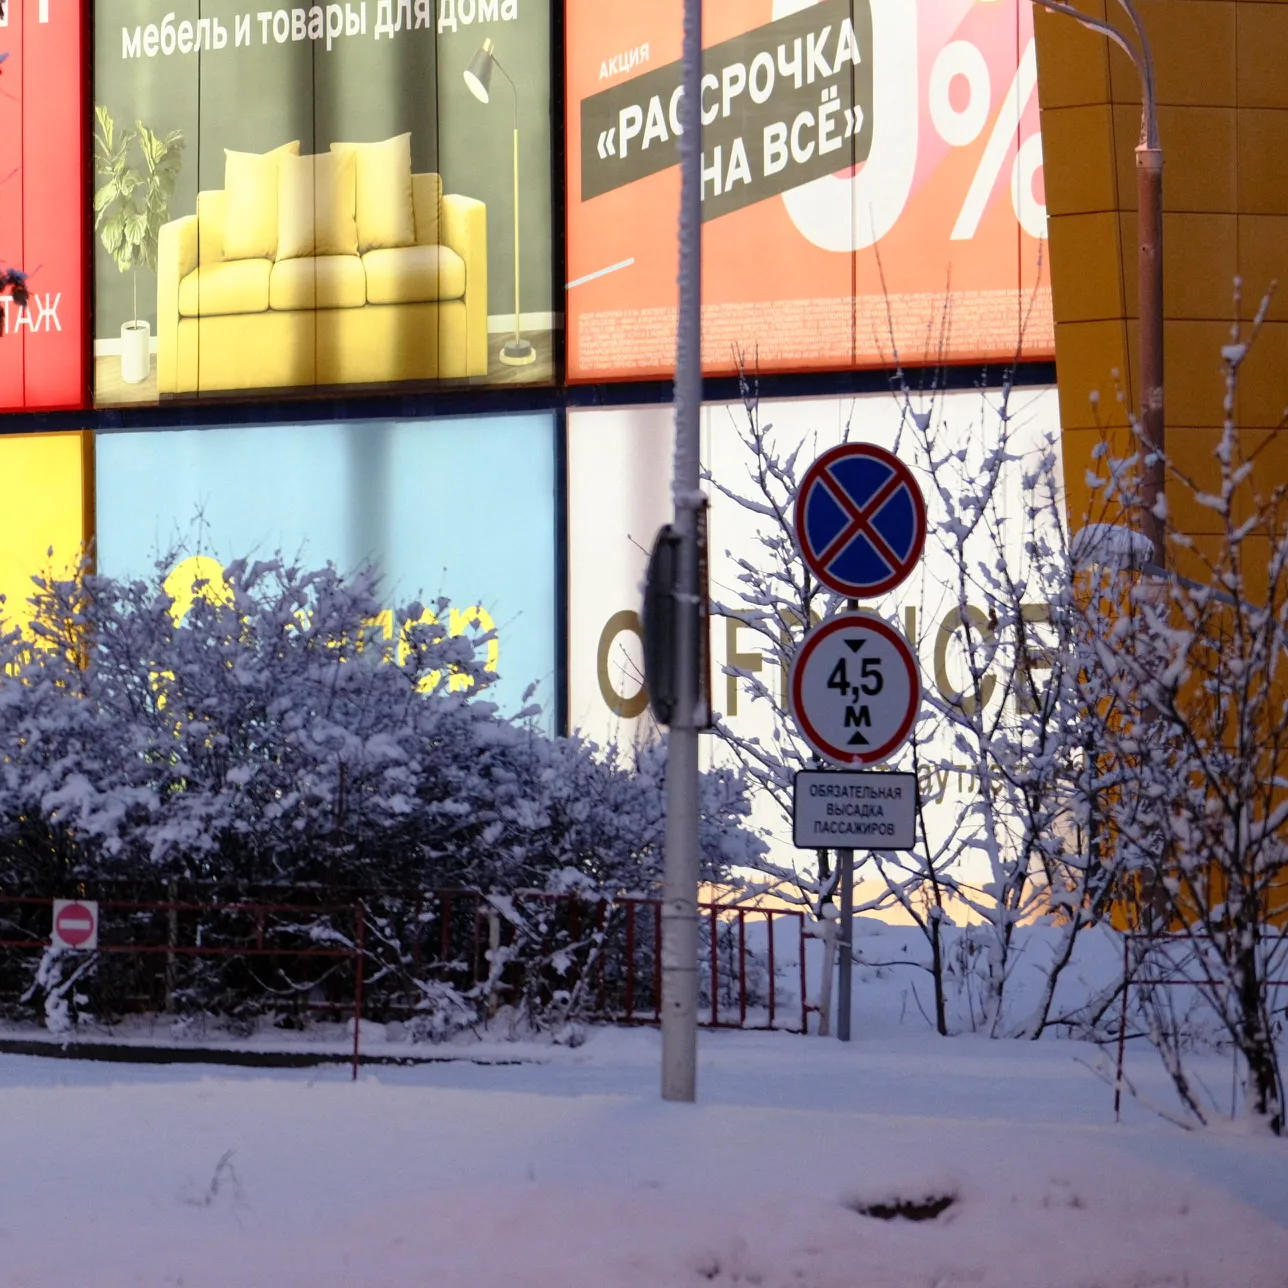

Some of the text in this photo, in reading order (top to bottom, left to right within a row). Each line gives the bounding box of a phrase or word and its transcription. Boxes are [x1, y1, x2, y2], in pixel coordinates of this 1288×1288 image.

[121, 12, 227, 59] мебель
[234, 13, 251, 48] и
[257, 1, 367, 51] товары
[598, 42, 650, 81] АКЦИЯ
[699, 84, 864, 201] НА ВСЁ»
[826, 657, 884, 704] 4,5
[809, 784, 902, 800] ОБЯЗАТЕЛЬНАЯ
[826, 803, 884, 818] ВЫСАДКА
[814, 820, 895, 836] ПАССАЖИРОВ
